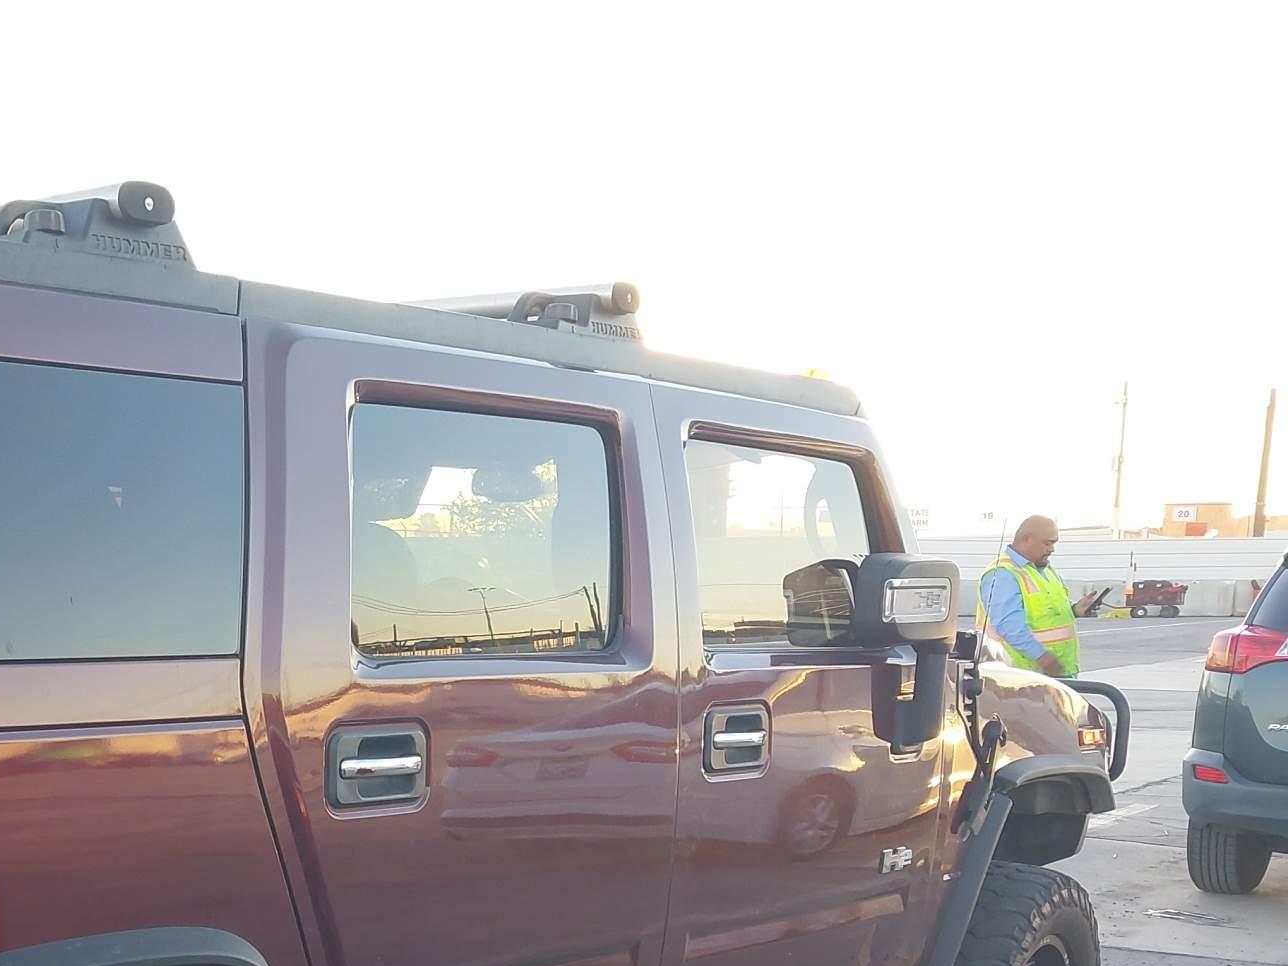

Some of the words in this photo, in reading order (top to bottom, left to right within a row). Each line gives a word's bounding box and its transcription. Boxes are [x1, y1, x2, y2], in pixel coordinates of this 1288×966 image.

[92, 234, 187, 261] HUMMER
[1177, 510, 1190, 518] 20
[880, 846, 913, 874] H2
